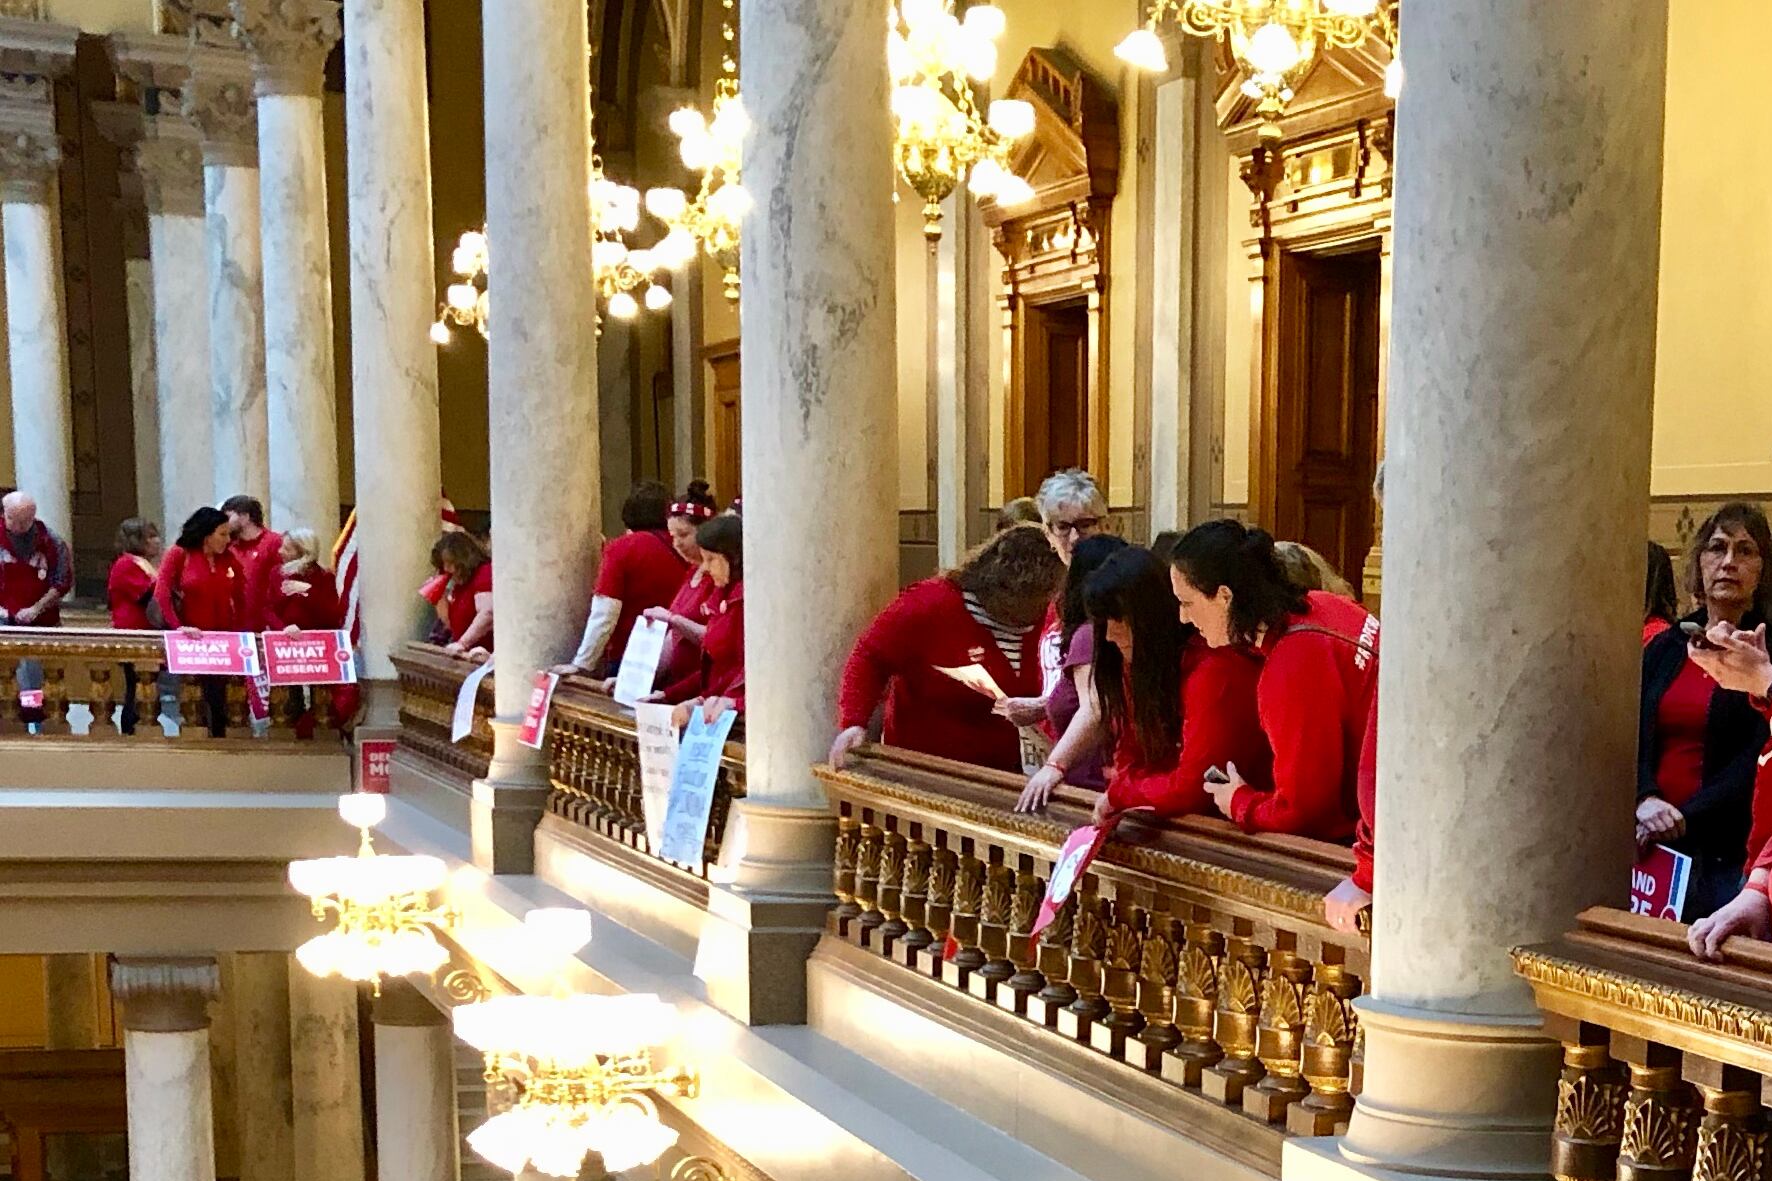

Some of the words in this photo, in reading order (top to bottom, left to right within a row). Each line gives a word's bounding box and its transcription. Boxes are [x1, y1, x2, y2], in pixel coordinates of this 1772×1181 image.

[176, 643, 230, 653] WHAT
[274, 645, 326, 659] WHAT
[276, 664, 329, 675] DESERVE
